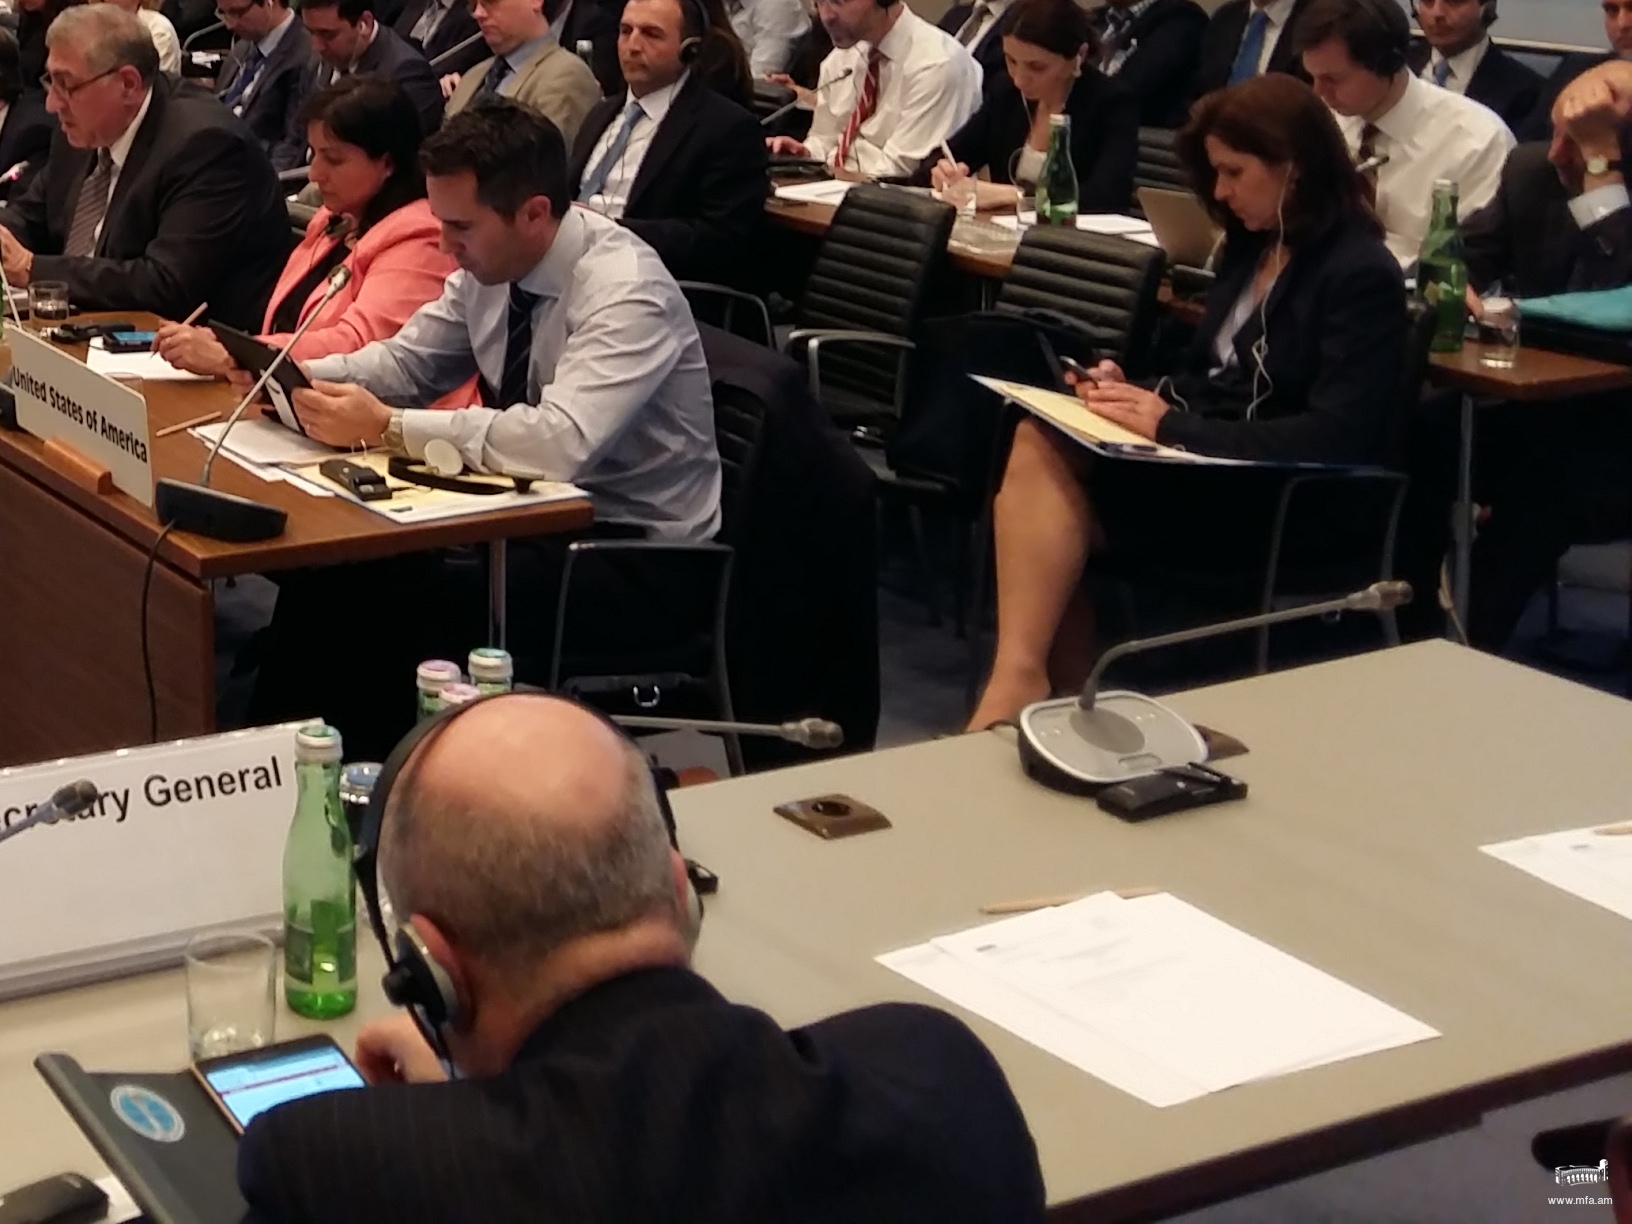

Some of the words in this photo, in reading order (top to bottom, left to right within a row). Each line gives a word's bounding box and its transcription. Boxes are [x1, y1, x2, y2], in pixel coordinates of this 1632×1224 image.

[12, 366, 47, 403] United
[49, 387, 84, 425] States
[86, 409, 98, 431] of
[100, 415, 148, 464] America
[144, 755, 283, 807] General
